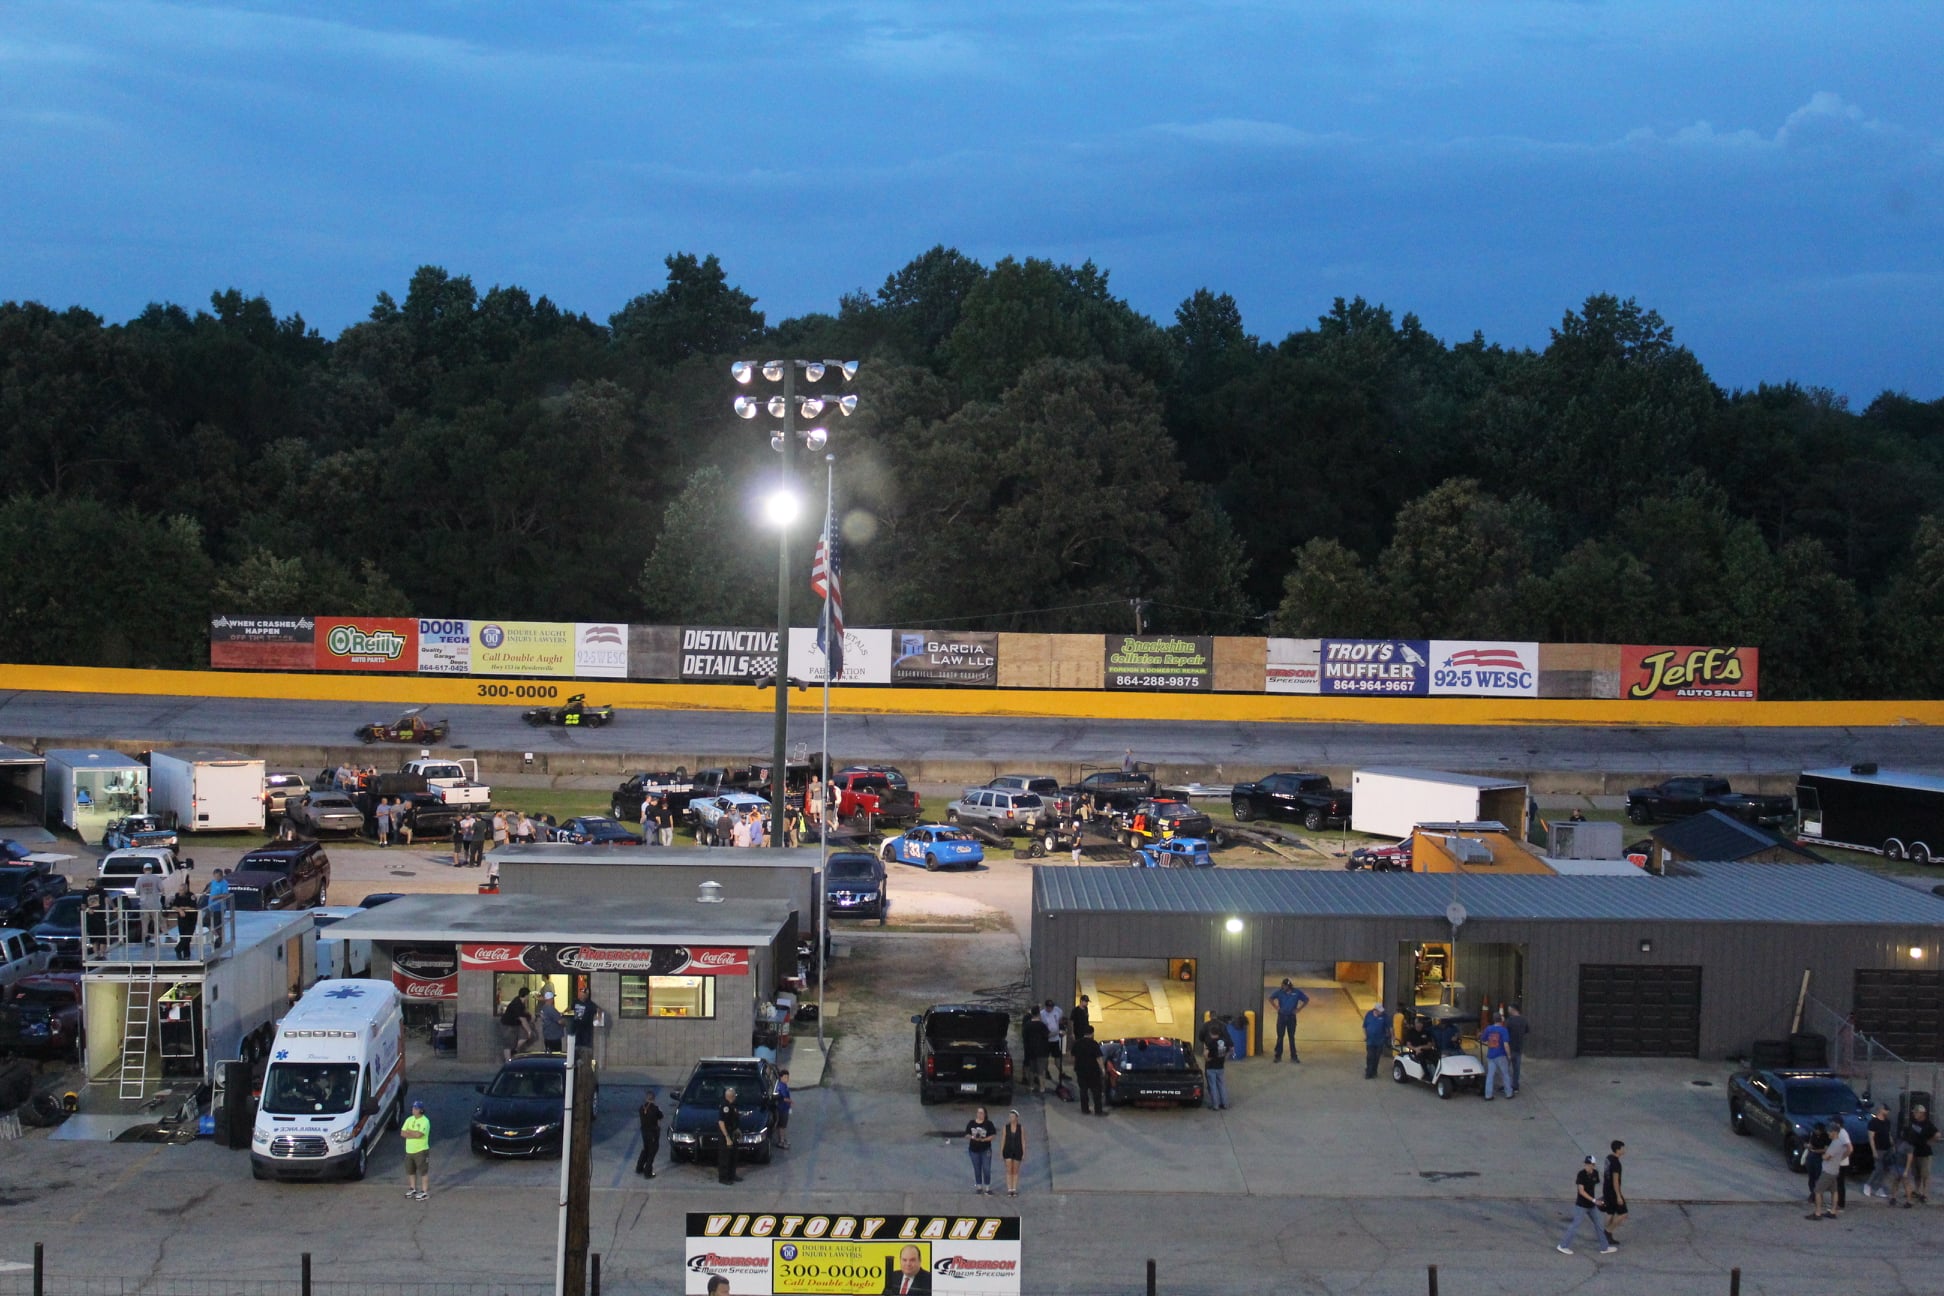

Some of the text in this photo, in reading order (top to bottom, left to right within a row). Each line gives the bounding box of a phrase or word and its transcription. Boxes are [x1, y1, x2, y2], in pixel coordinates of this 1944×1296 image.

[257, 620, 296, 628] CRASHES
[420, 620, 464, 635] DOOR
[329, 627, 403, 657] O'Reilly
[439, 636, 470, 644] TECH
[534, 636, 567, 644] LAWYERS
[683, 630, 779, 652] DISTINCTIVE
[928, 641, 985, 654] GARCIA
[1327, 643, 1394, 661] TROY'S
[482, 652, 563, 665] Call Double Aught
[596, 652, 626, 665] WESC
[682, 654, 750, 676] DETAILS
[931, 654, 994, 666] LAW LLC
[1110, 653, 1205, 667] Collision Repair
[419, 664, 468, 672] 864-617-0425
[809, 667, 866, 675] FABTION
[1326, 663, 1415, 678] MUFFLER
[1631, 646, 1742, 697] Jeff's
[1116, 675, 1199, 687] 864-288-9875
[1333, 680, 1415, 691] 864-964-9667
[1475, 670, 1533, 689] WESC
[477, 684, 558, 698] 300-0000
[1677, 689, 1753, 698] AUTO SALES
[908, 841, 921, 858] 33
[474, 947, 511, 960] Coca-Cola
[578, 945, 651, 960] ANDERSON
[700, 951, 737, 965] Coca-Cola
[605, 961, 650, 969] SPEEDWAY
[406, 982, 445, 996] Coca-Cola
[704, 1214, 1001, 1240] VICTORY LANE
[704, 1252, 770, 1267] ANDERSON
[950, 1255, 1017, 1270] ANDERSON
[728, 1266, 769, 1274] SPEEDWAY
[779, 1264, 882, 1279] 300-0000
[975, 1269, 1016, 1277] SPEEDWAY
[783, 1278, 875, 1289] Call Double Aught
